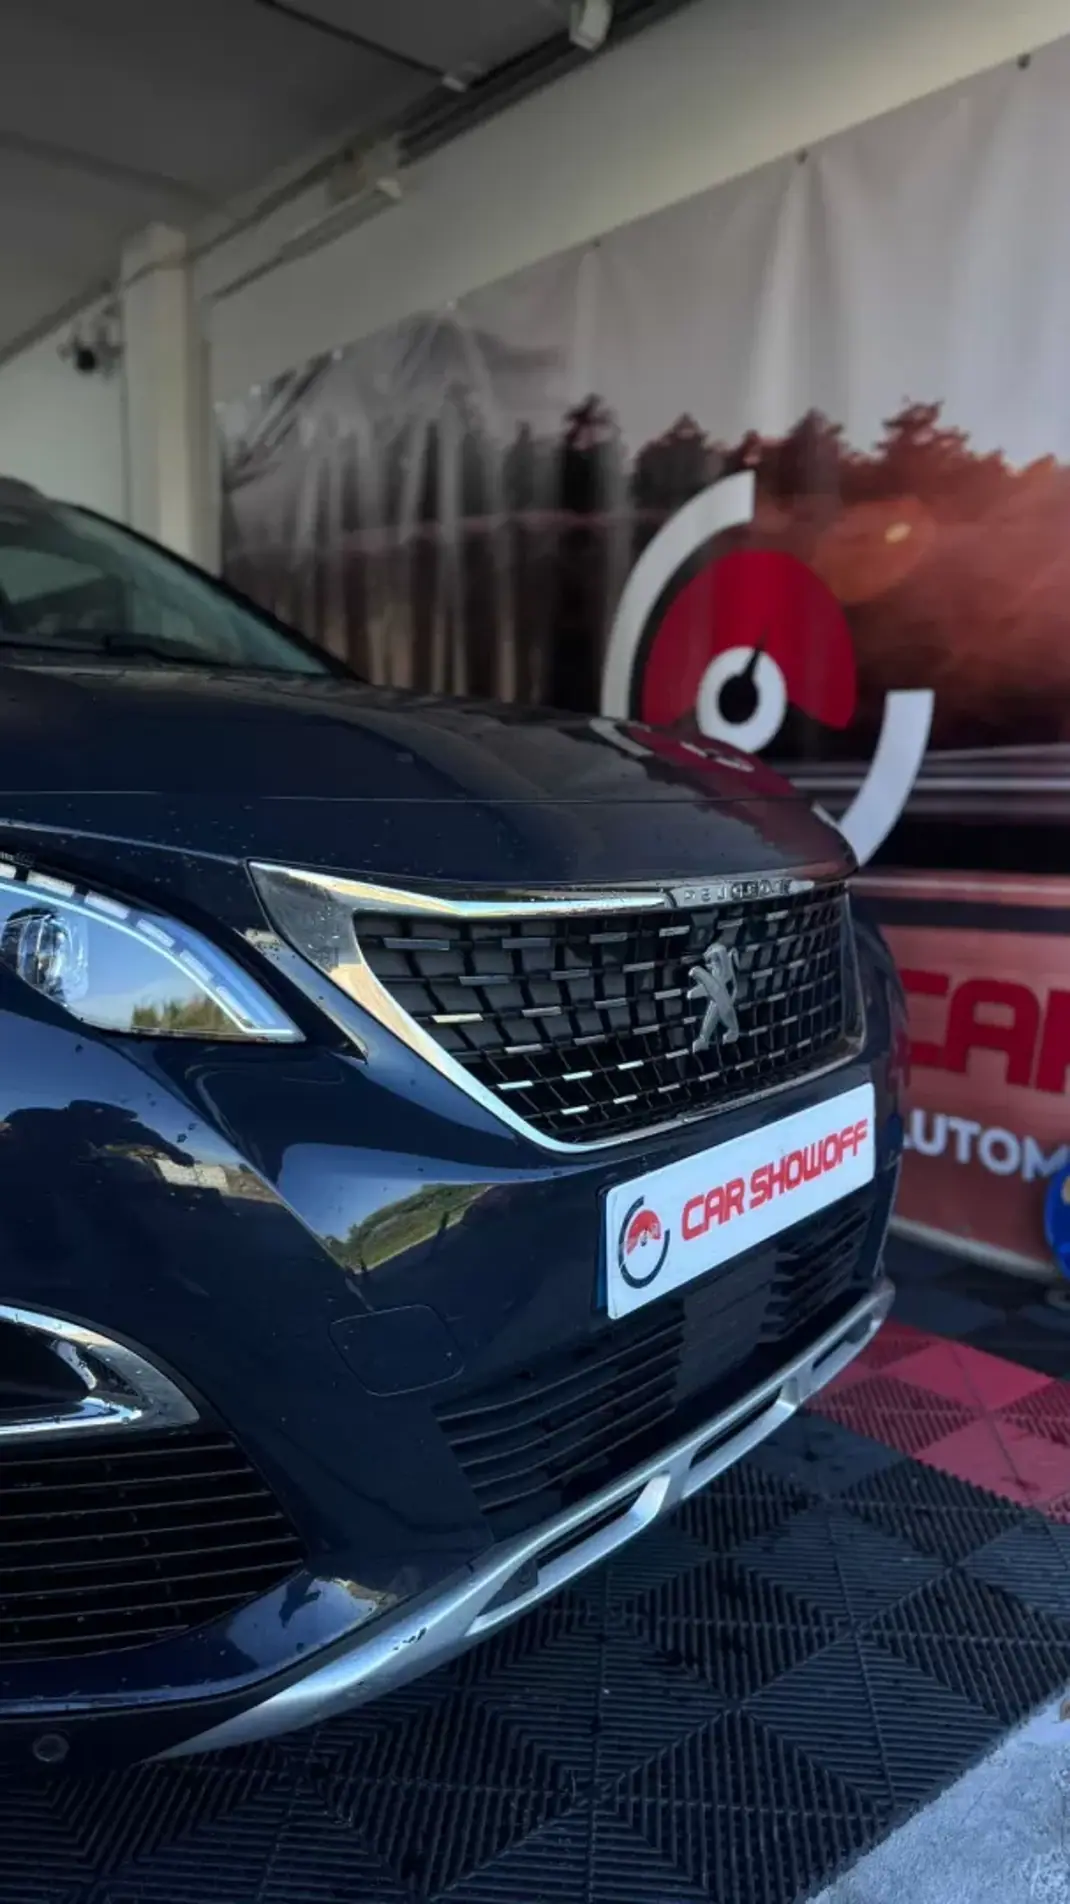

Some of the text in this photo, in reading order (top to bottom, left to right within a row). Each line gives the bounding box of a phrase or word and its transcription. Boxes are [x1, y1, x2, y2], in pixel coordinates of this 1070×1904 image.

[681, 1118, 868, 1241] CAR SHOWOFF
[903, 1108, 1070, 1181] UTOM
